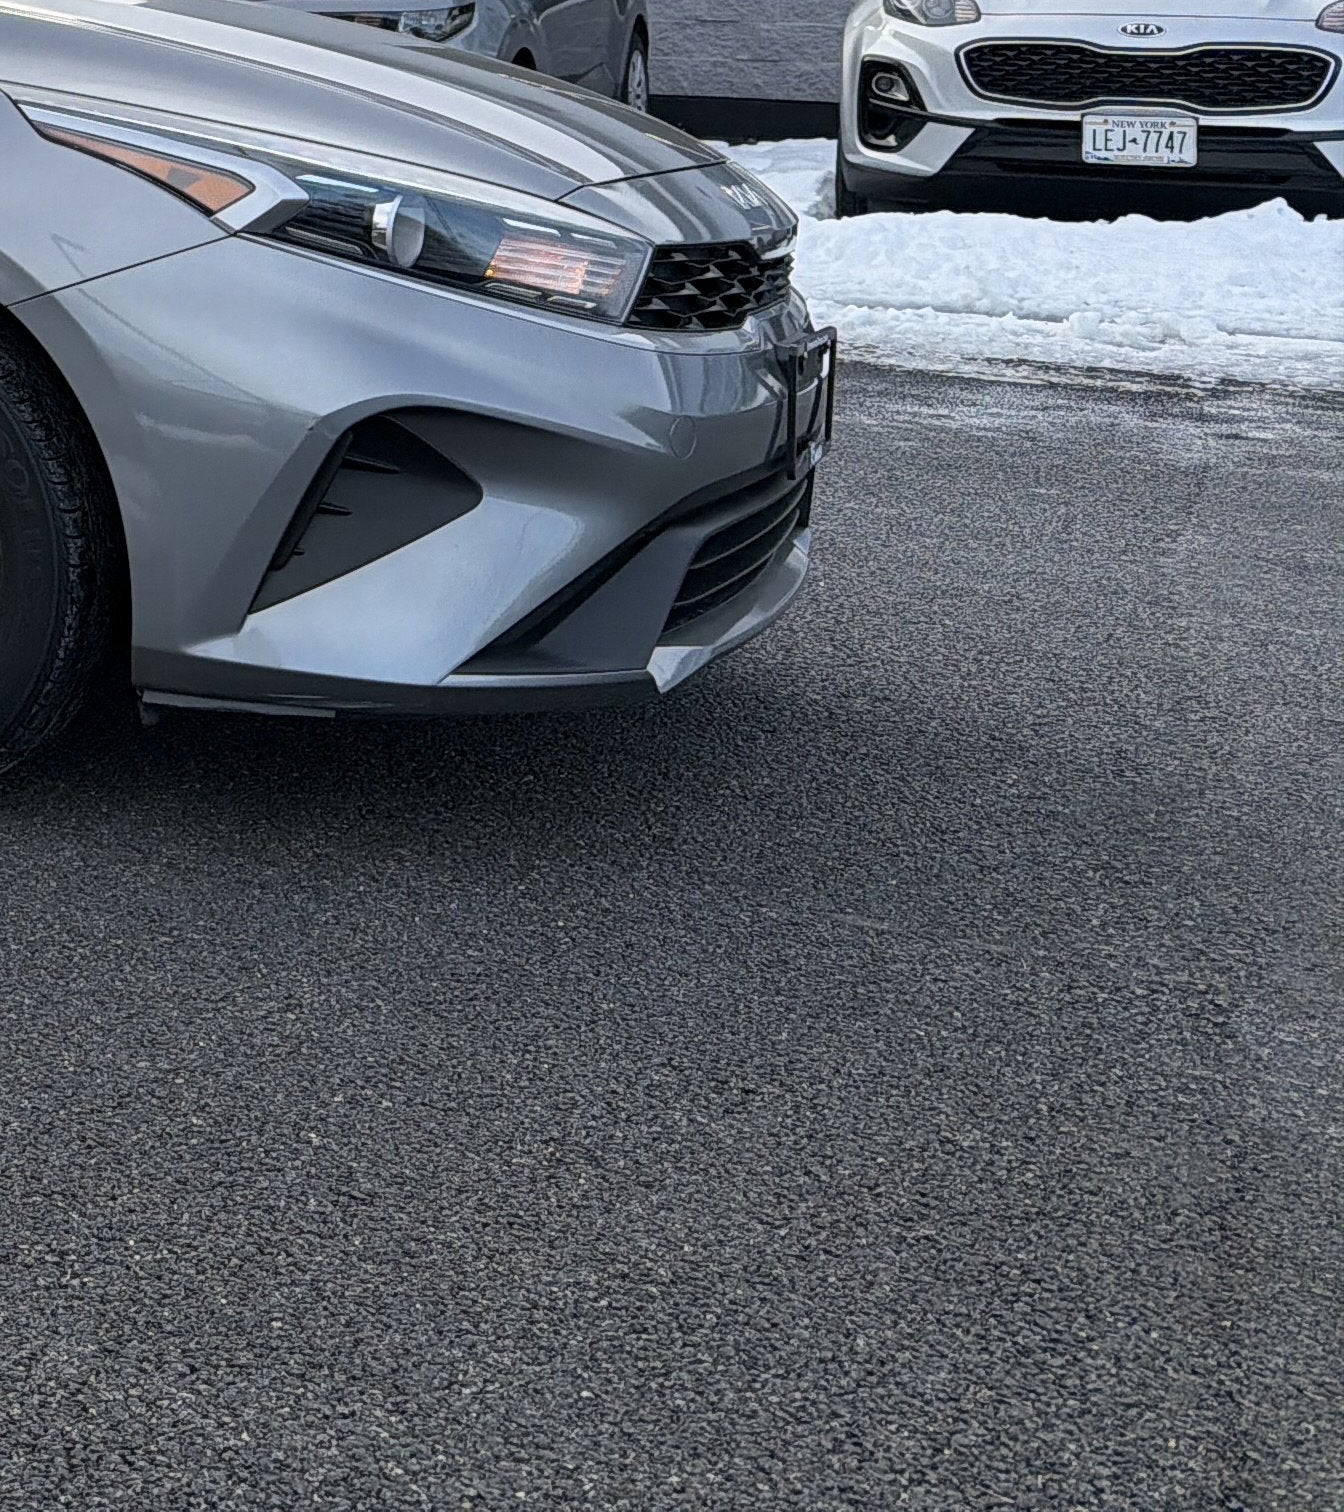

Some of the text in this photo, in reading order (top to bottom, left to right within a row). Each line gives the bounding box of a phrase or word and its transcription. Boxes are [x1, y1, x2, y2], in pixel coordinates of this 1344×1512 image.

[1126, 24, 1159, 34] KIA
[1112, 119, 1168, 129] NEW YORK
